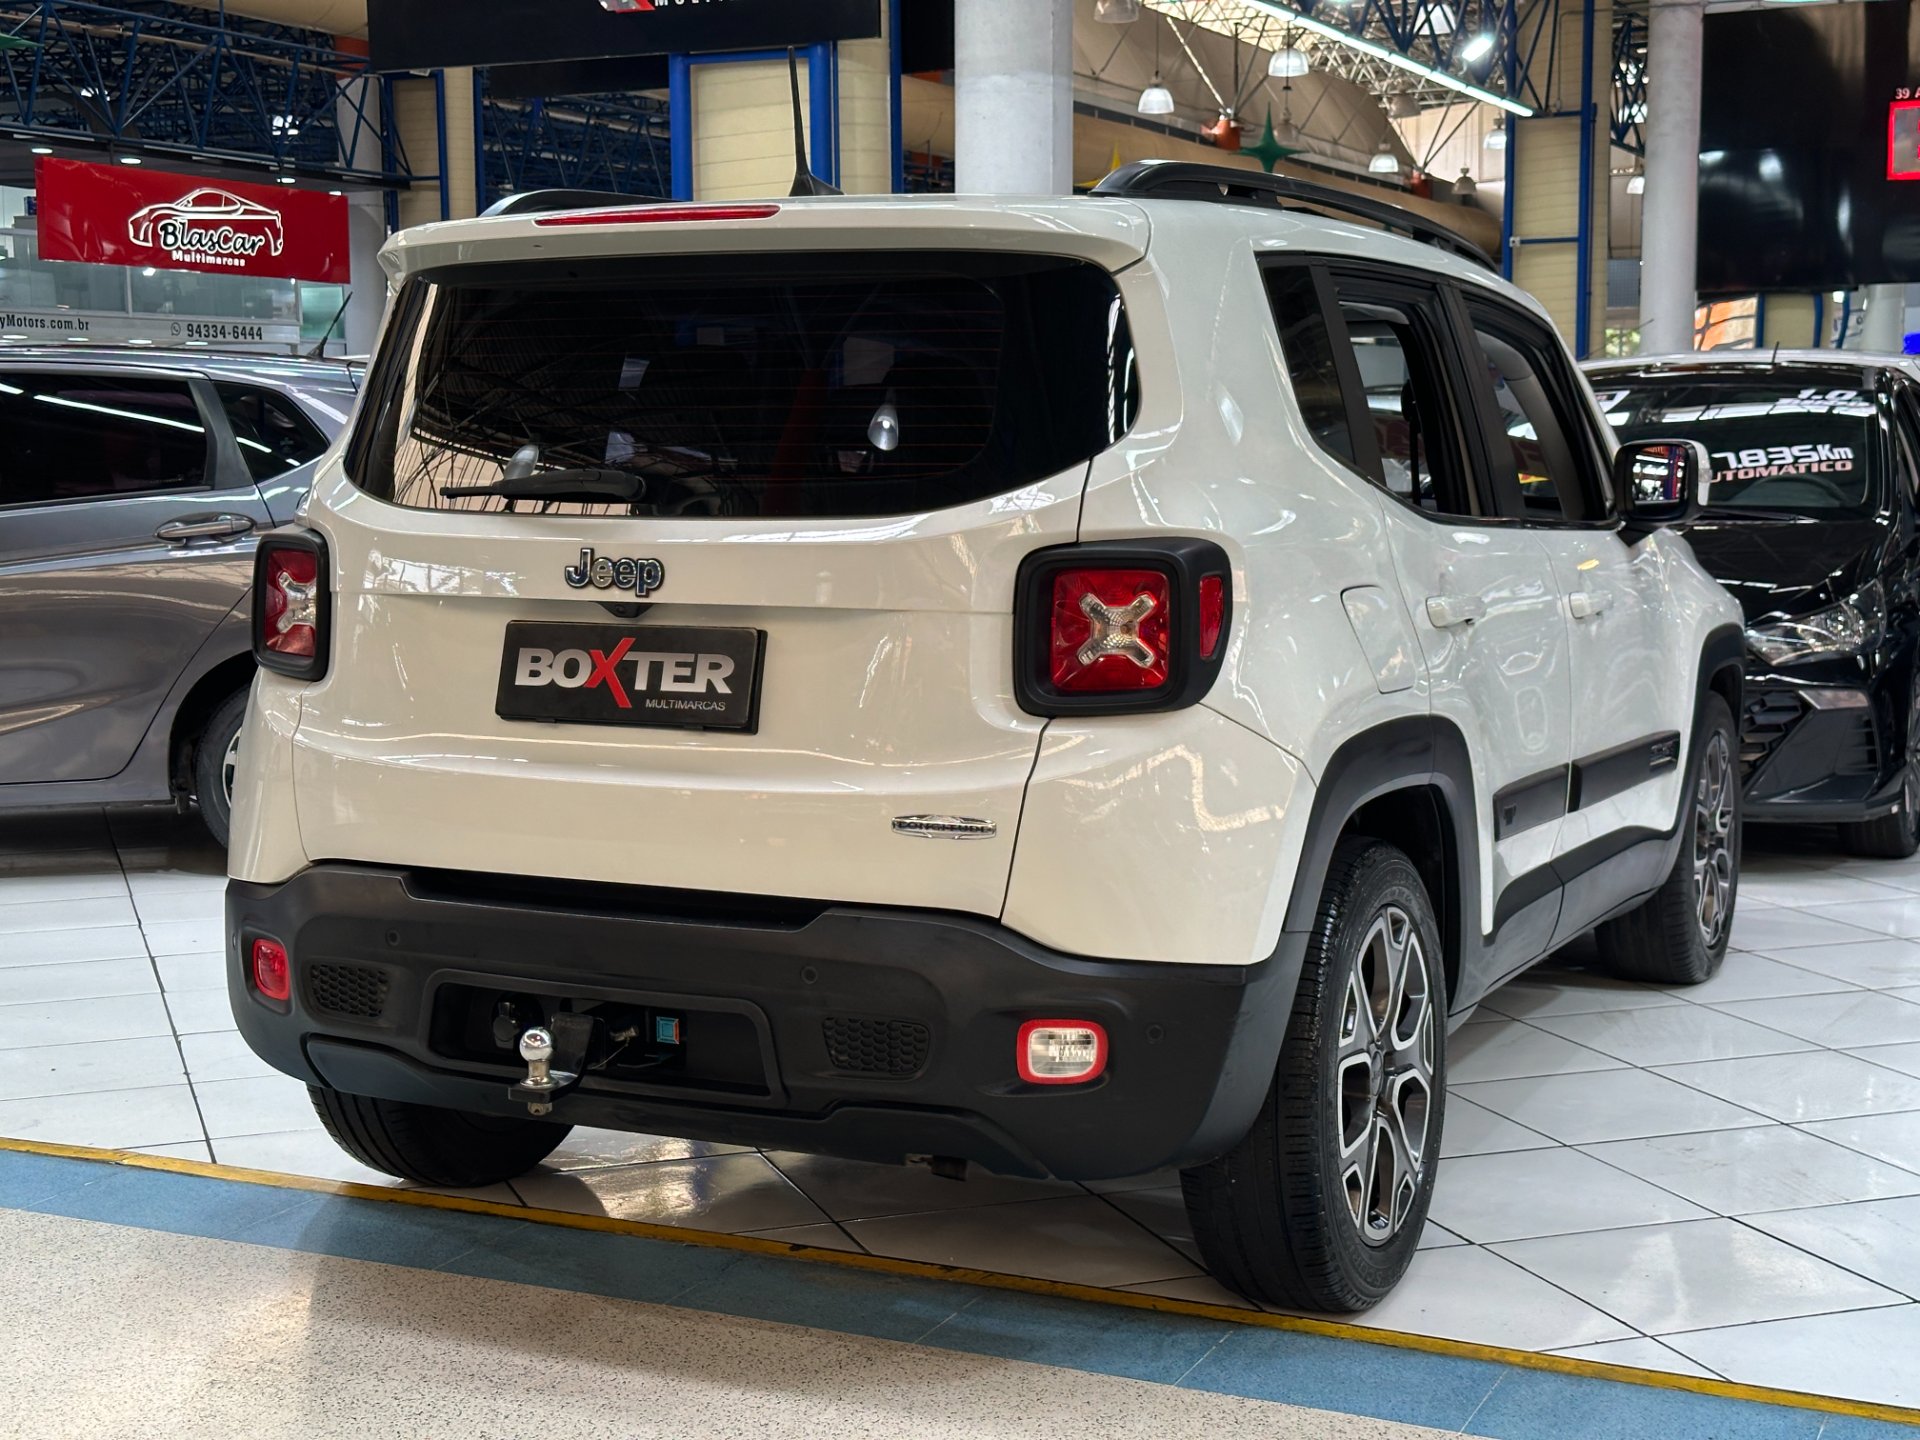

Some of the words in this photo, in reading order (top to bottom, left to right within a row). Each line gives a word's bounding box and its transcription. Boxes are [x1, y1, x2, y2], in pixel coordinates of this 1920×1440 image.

[158, 219, 265, 256] BlasCar
[171, 250, 246, 267] Multimarcas
[186, 323, 263, 341] 94334-6444
[1711, 460, 1853, 483] UTOMATICO
[564, 547, 666, 598] Jeep
[514, 637, 736, 709] BOXTER
[645, 698, 727, 712] MULTIMARCAS
